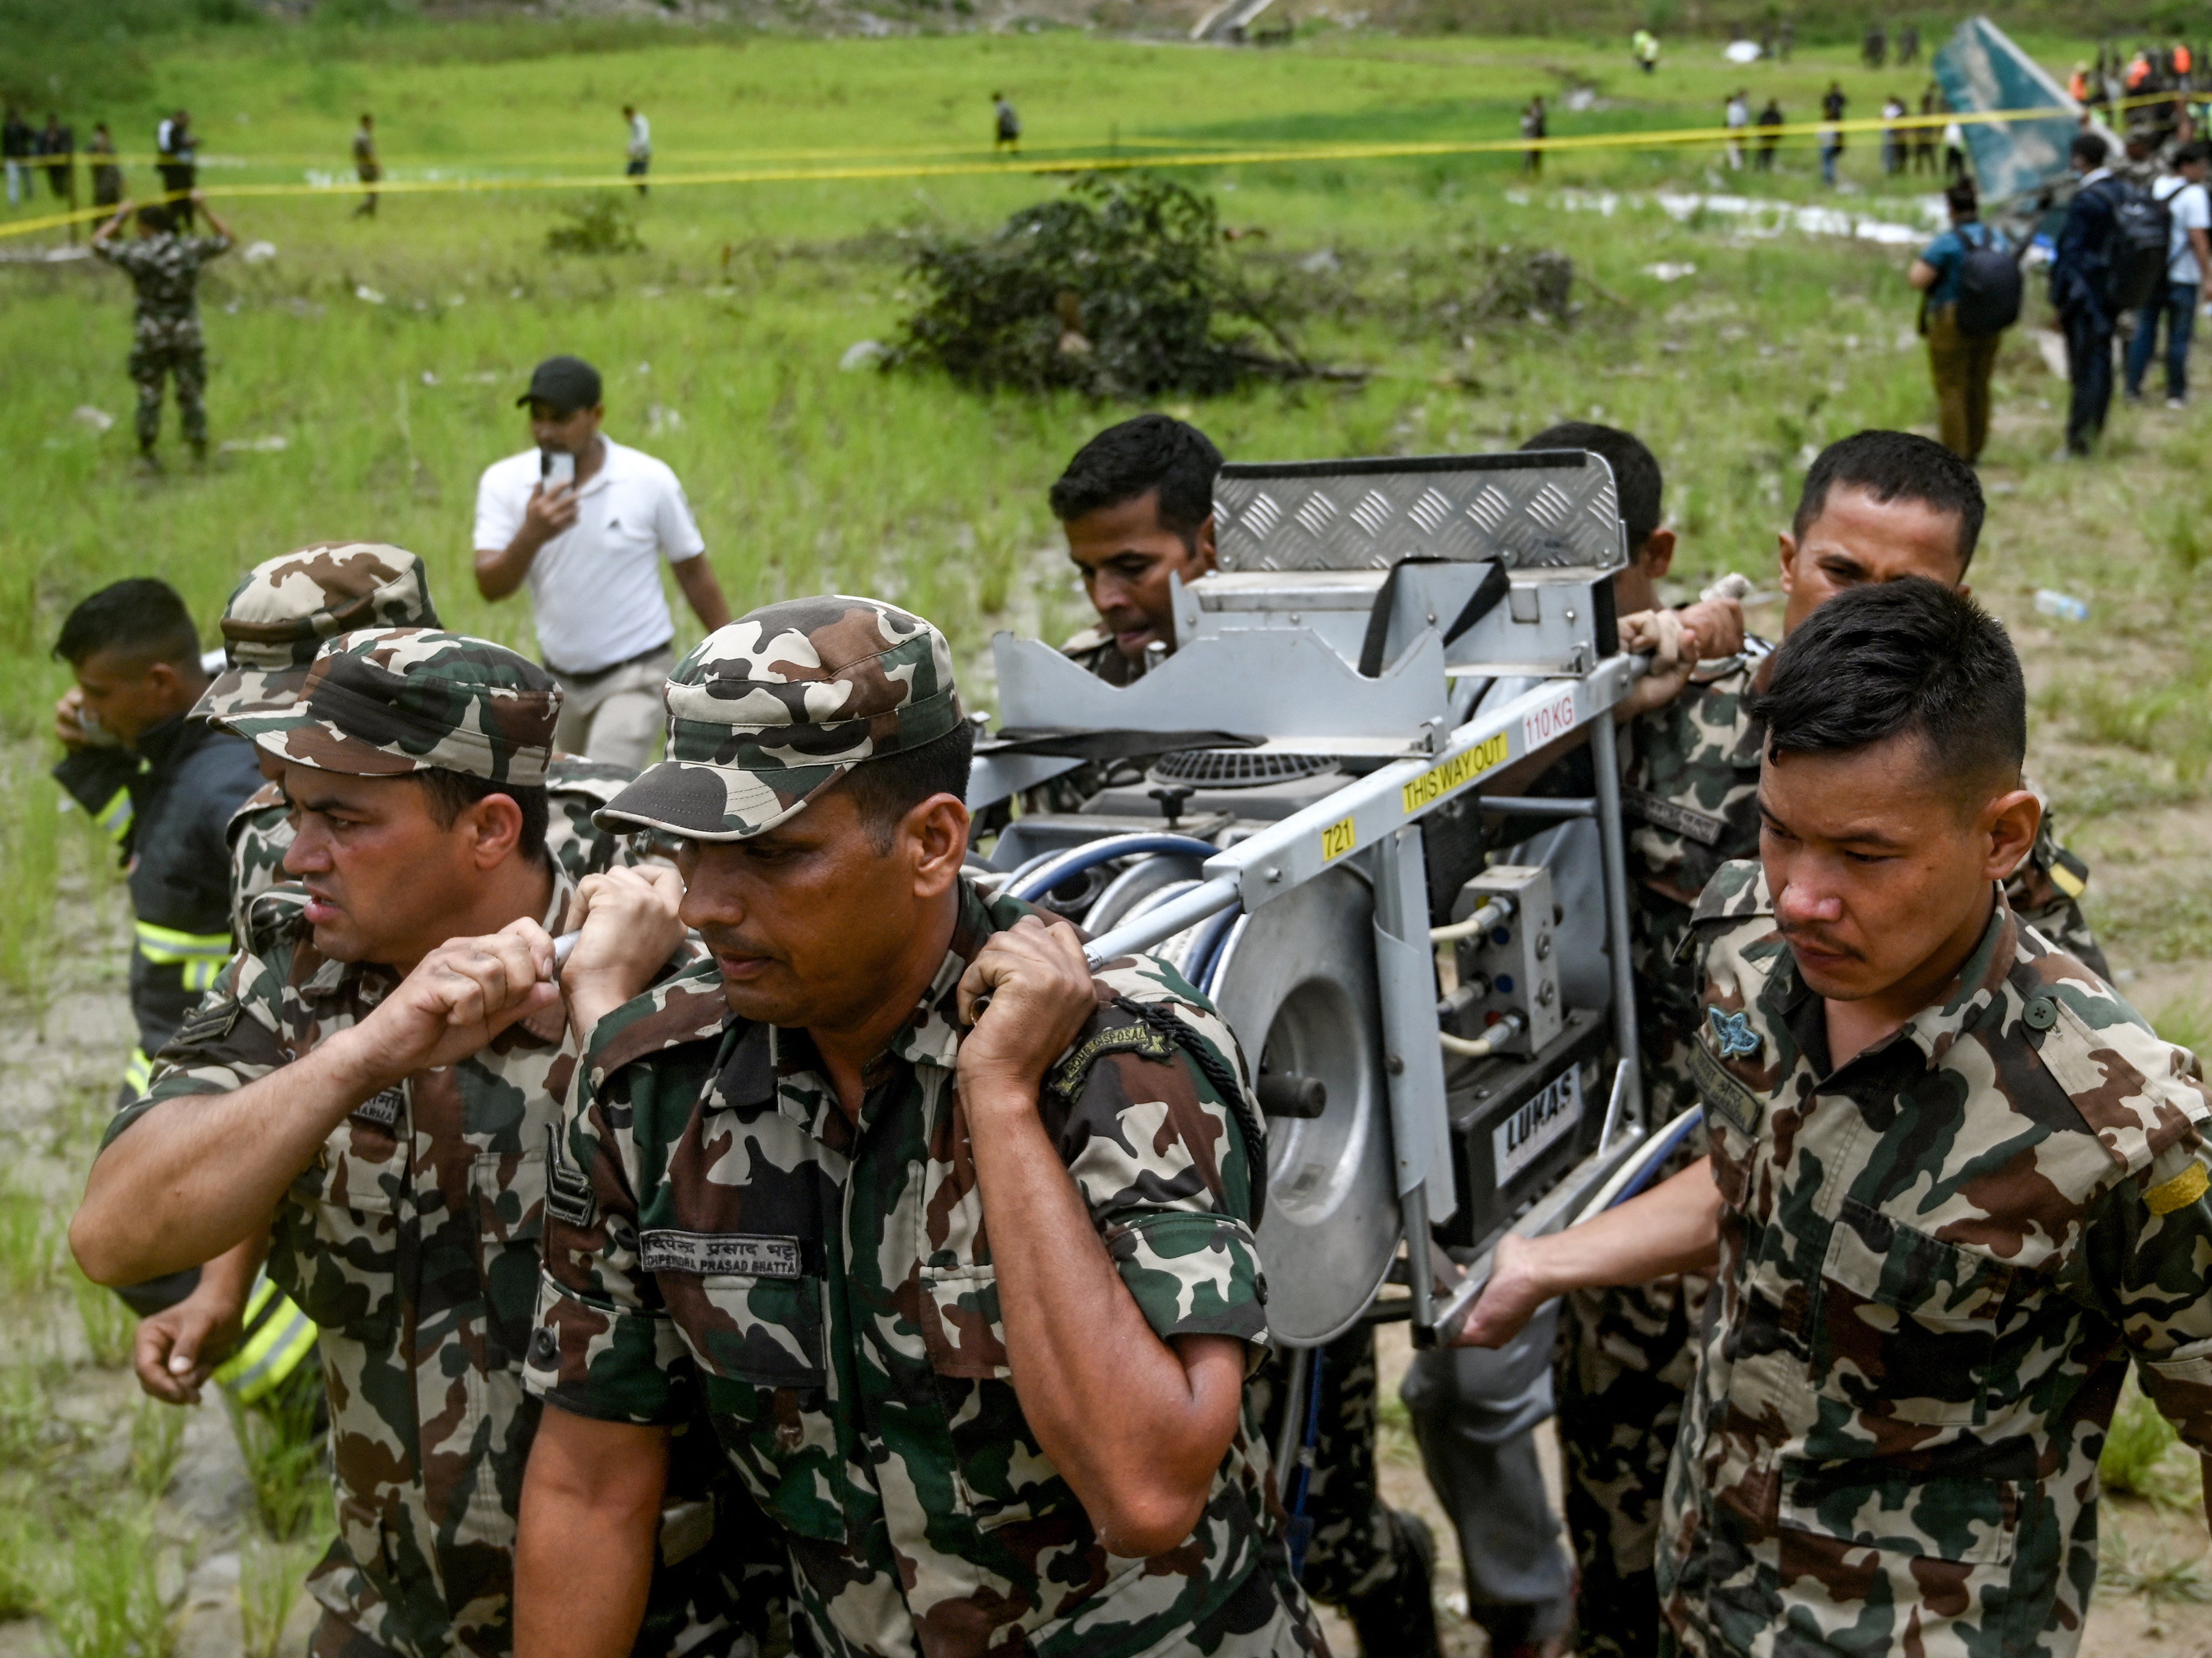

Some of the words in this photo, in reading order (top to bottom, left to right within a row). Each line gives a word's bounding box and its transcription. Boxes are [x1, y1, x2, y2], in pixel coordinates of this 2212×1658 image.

[1526, 708, 1550, 745] 110
[1552, 697, 1573, 731] KG
[1404, 771, 1437, 809] THIS
[1439, 750, 1470, 790] WAY
[1474, 735, 1501, 770] OUT
[1324, 820, 1350, 857] 721
[1093, 1027, 1145, 1047] DISPOSAL
[1506, 1070, 1572, 1157] LUKAS
[700, 1259, 748, 1271] PRASAD
[752, 1260, 795, 1273] BHATTA
